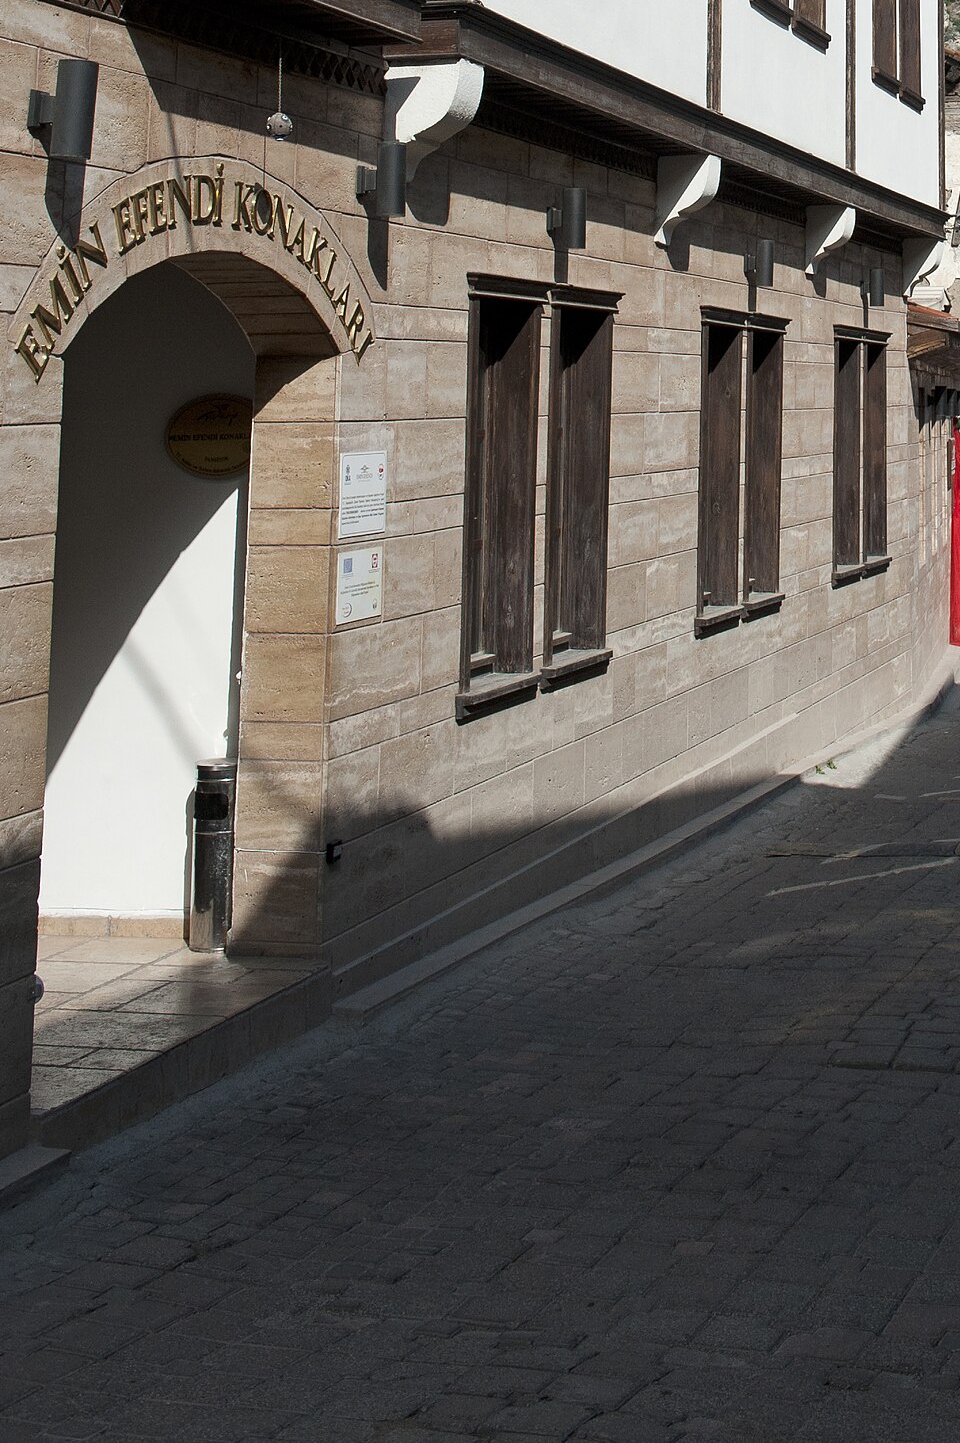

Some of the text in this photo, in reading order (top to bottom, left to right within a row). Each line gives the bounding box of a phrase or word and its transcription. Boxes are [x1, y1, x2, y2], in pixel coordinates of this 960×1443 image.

[15, 162, 374, 384] EMİN EFENDİ KONAKLARI
